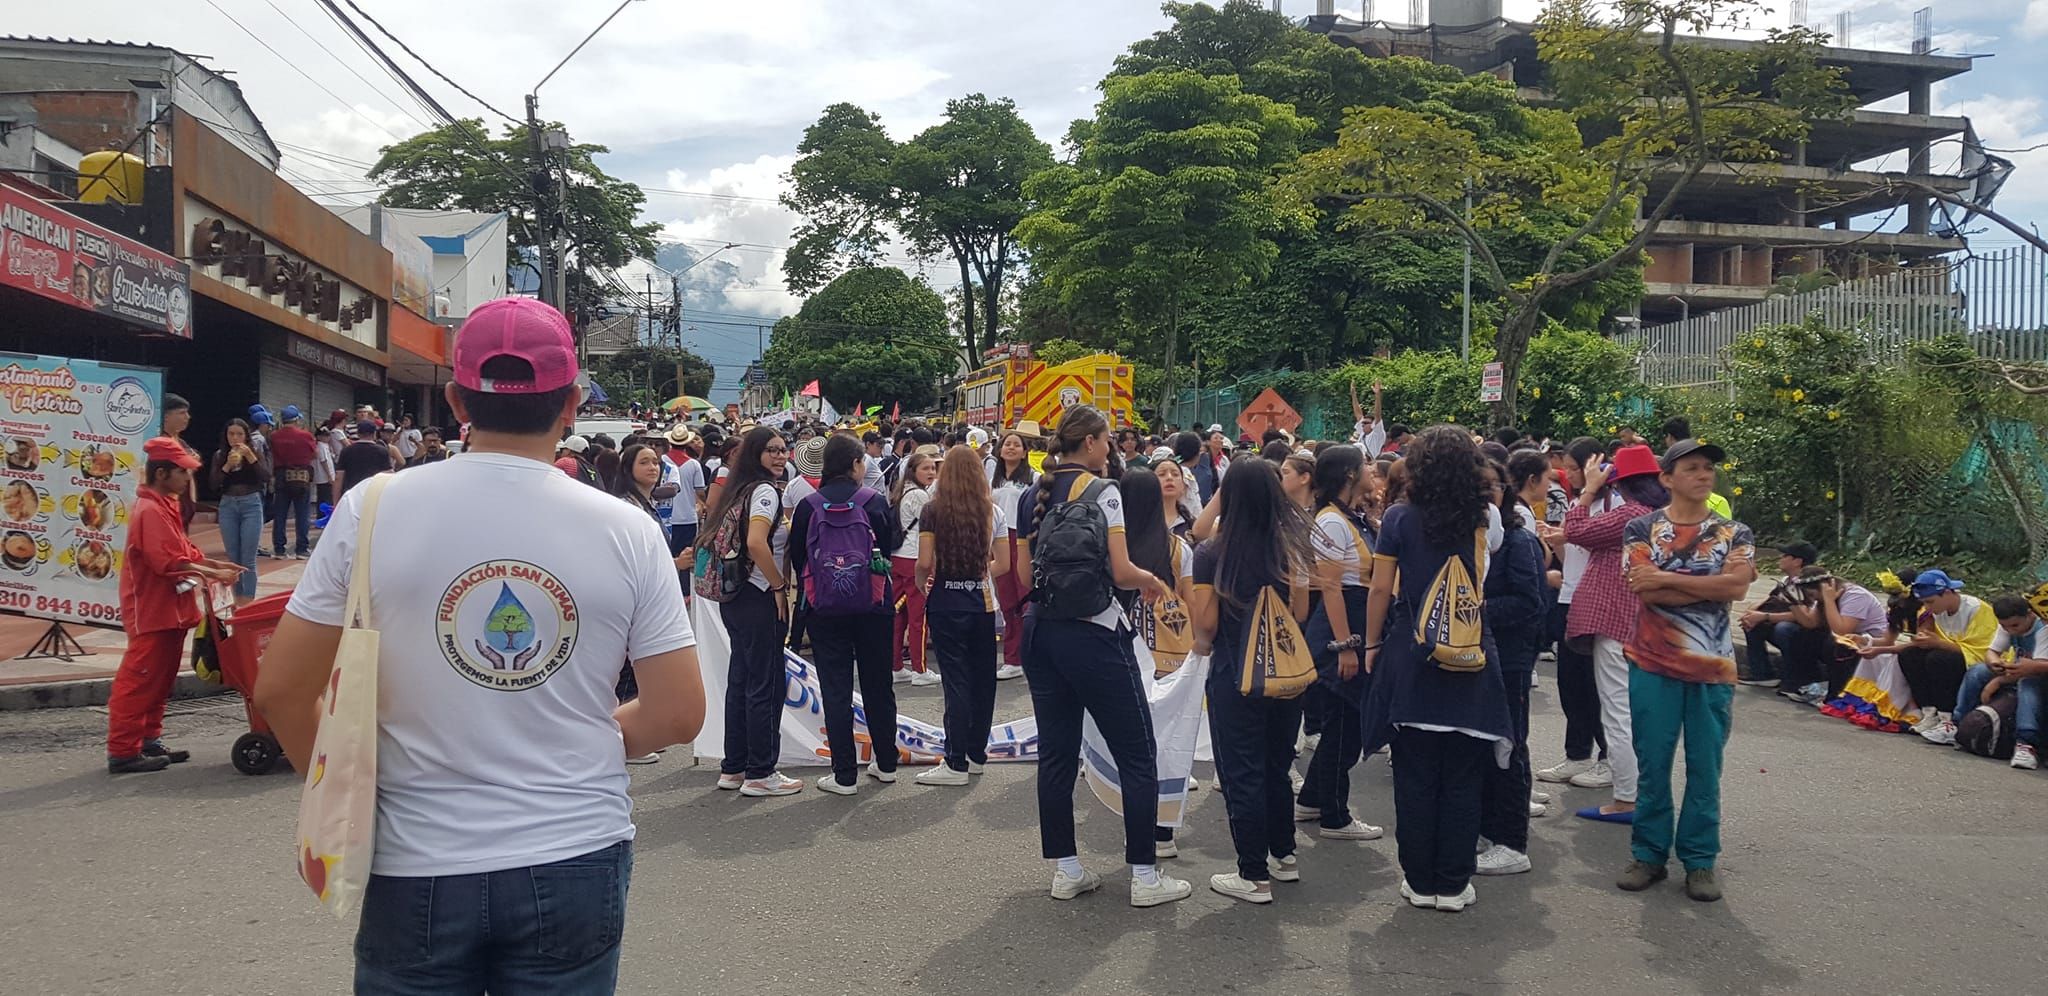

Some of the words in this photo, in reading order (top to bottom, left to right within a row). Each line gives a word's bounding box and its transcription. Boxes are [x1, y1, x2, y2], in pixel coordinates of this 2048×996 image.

[2, 203, 71, 252] AMERICAN
[73, 431, 128, 446] Pescados
[71, 476, 121, 491] Ceviches
[75, 528, 112, 542] Pastas
[440, 564, 507, 622] FUNDACIÓN
[511, 565, 542, 583] SAN
[542, 577, 575, 622] DIMAS
[944, 581, 964, 590] PROM
[0, 590, 31, 608] 310
[37, 595, 72, 615] 844
[444, 634, 493, 684] PROTEGEMOS
[496, 677, 507, 687] LA
[545, 659, 558, 672] DE
[555, 636, 571, 661] VIDA
